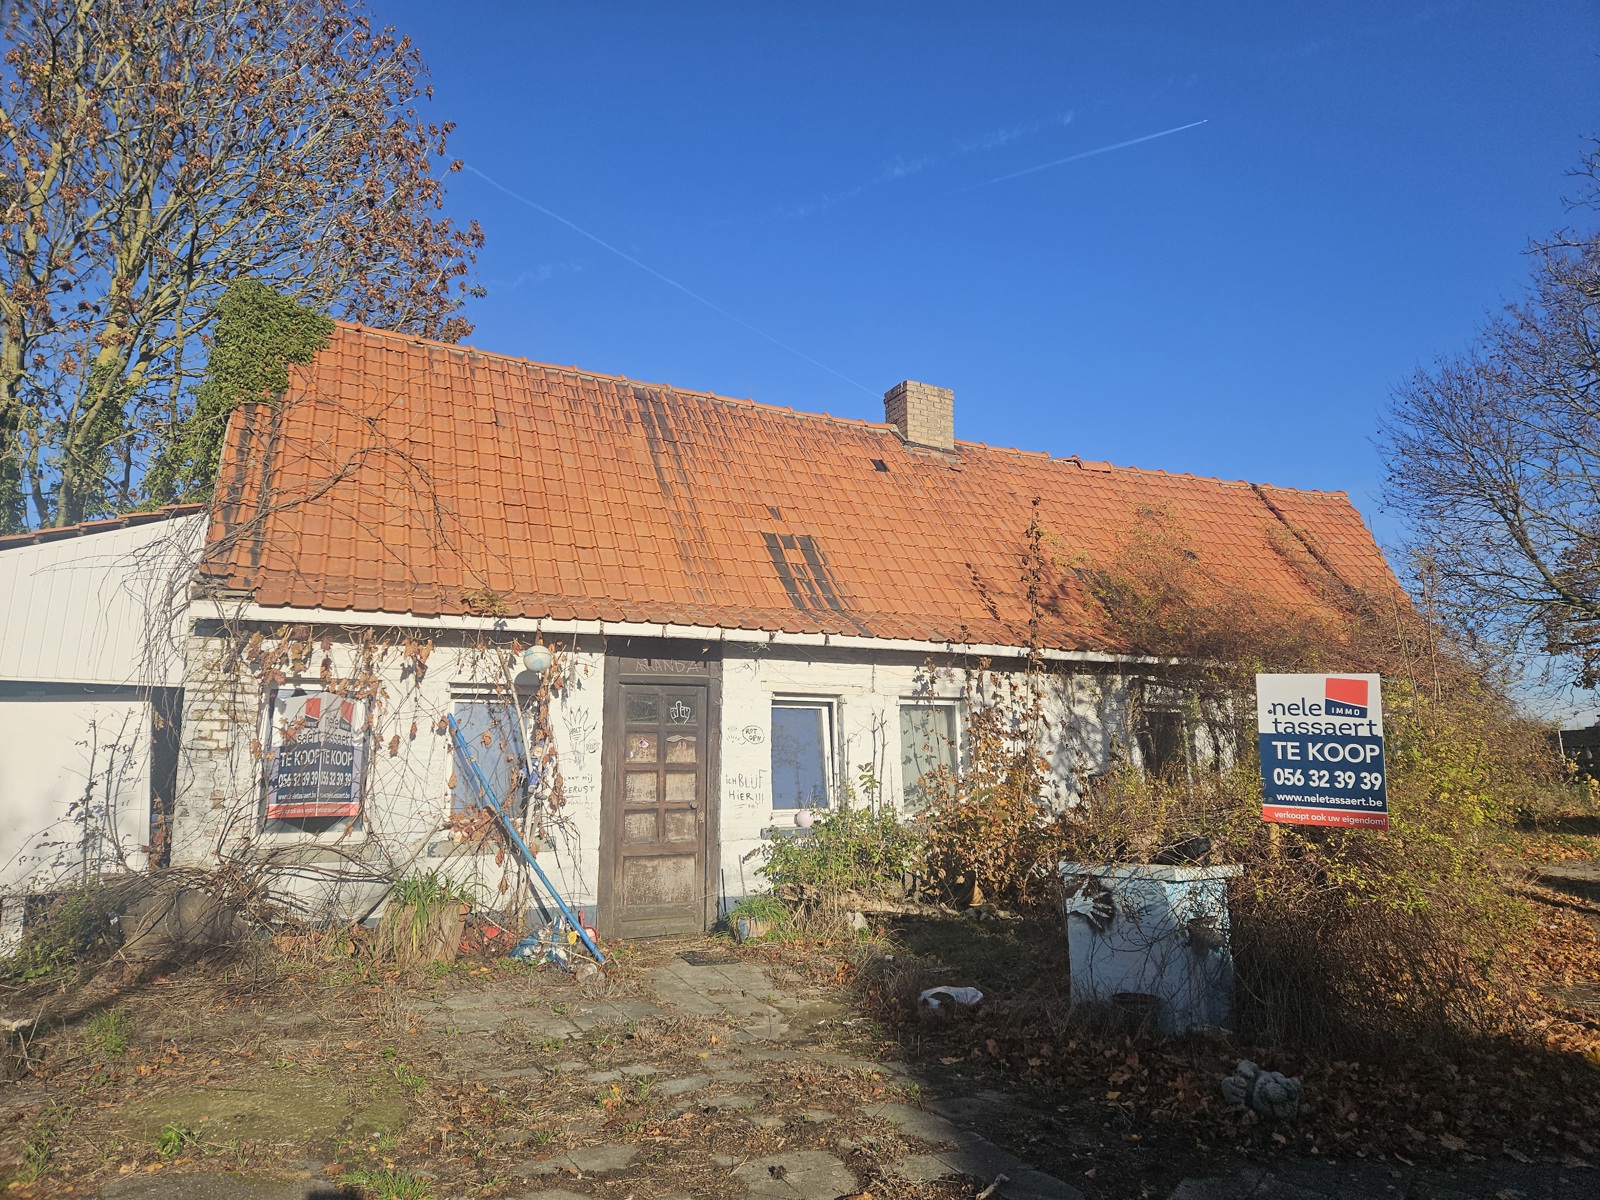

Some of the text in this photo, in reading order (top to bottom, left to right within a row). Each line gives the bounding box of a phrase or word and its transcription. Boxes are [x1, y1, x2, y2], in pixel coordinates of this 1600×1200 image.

[1271, 697, 1322, 717] nele
[1331, 707, 1360, 716] IMMO
[1271, 717, 1379, 737] tassaert
[280, 749, 320, 767] TE KOOP
[322, 749, 353, 767] TE KOOP
[1272, 741, 1380, 764] TE KOOP
[302, 771, 311, 786] 39
[310, 771, 318, 786] 39
[329, 772, 336, 786] 32
[336, 772, 344, 786] 39
[1273, 768, 1382, 791] 056 32 39 39
[1276, 793, 1383, 807] www.neletassaert.be
[1274, 811, 1310, 821] verkoopt
[1311, 813, 1326, 822] ook
[1342, 815, 1386, 826] eigendom!
